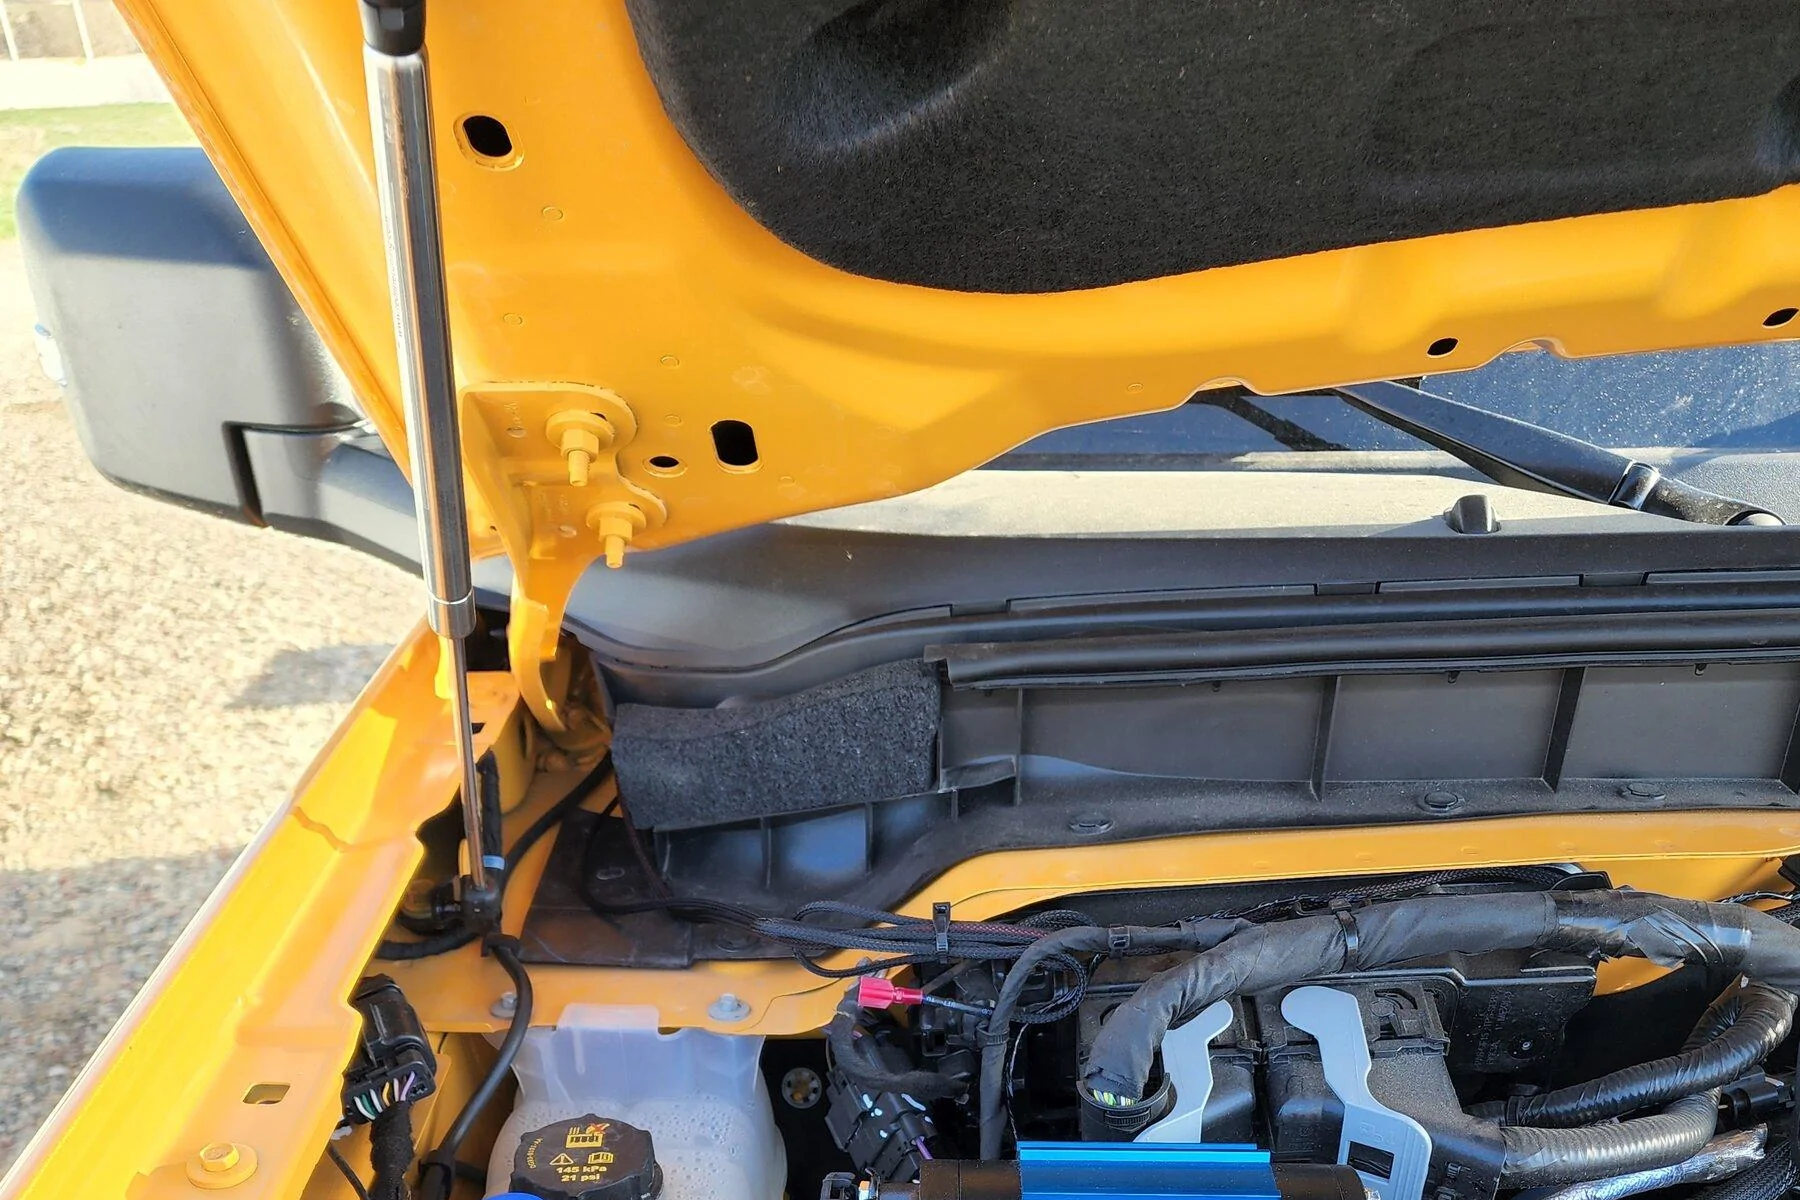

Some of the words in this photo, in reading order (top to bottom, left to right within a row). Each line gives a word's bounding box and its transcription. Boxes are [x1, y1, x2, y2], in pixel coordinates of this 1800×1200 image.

[556, 1166, 580, 1174] 145
[561, 1174, 576, 1182] 21
[581, 1174, 600, 1182] psi
